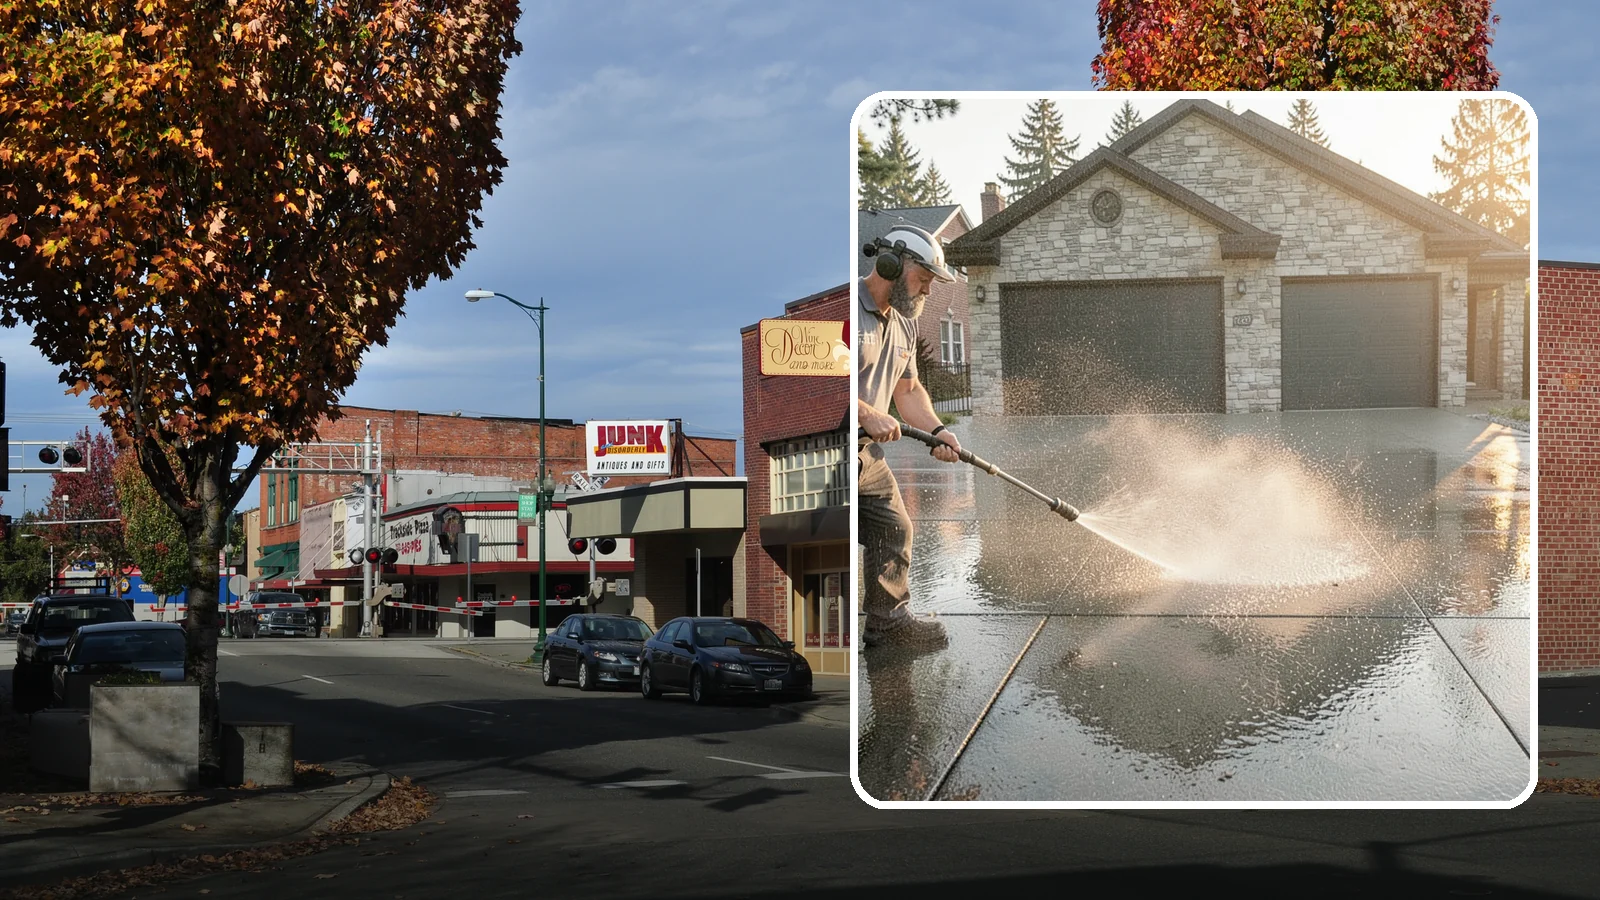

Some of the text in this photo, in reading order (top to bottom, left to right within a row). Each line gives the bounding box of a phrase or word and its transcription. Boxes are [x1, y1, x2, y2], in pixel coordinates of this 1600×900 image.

[596, 425, 665, 457] JUNK
[607, 446, 645, 454] DISORDERLY
[596, 460, 665, 470] ANTIQUES AND GIFTS
[572, 473, 589, 492] RAIL
[390, 519, 429, 539] Trackside Pizza
